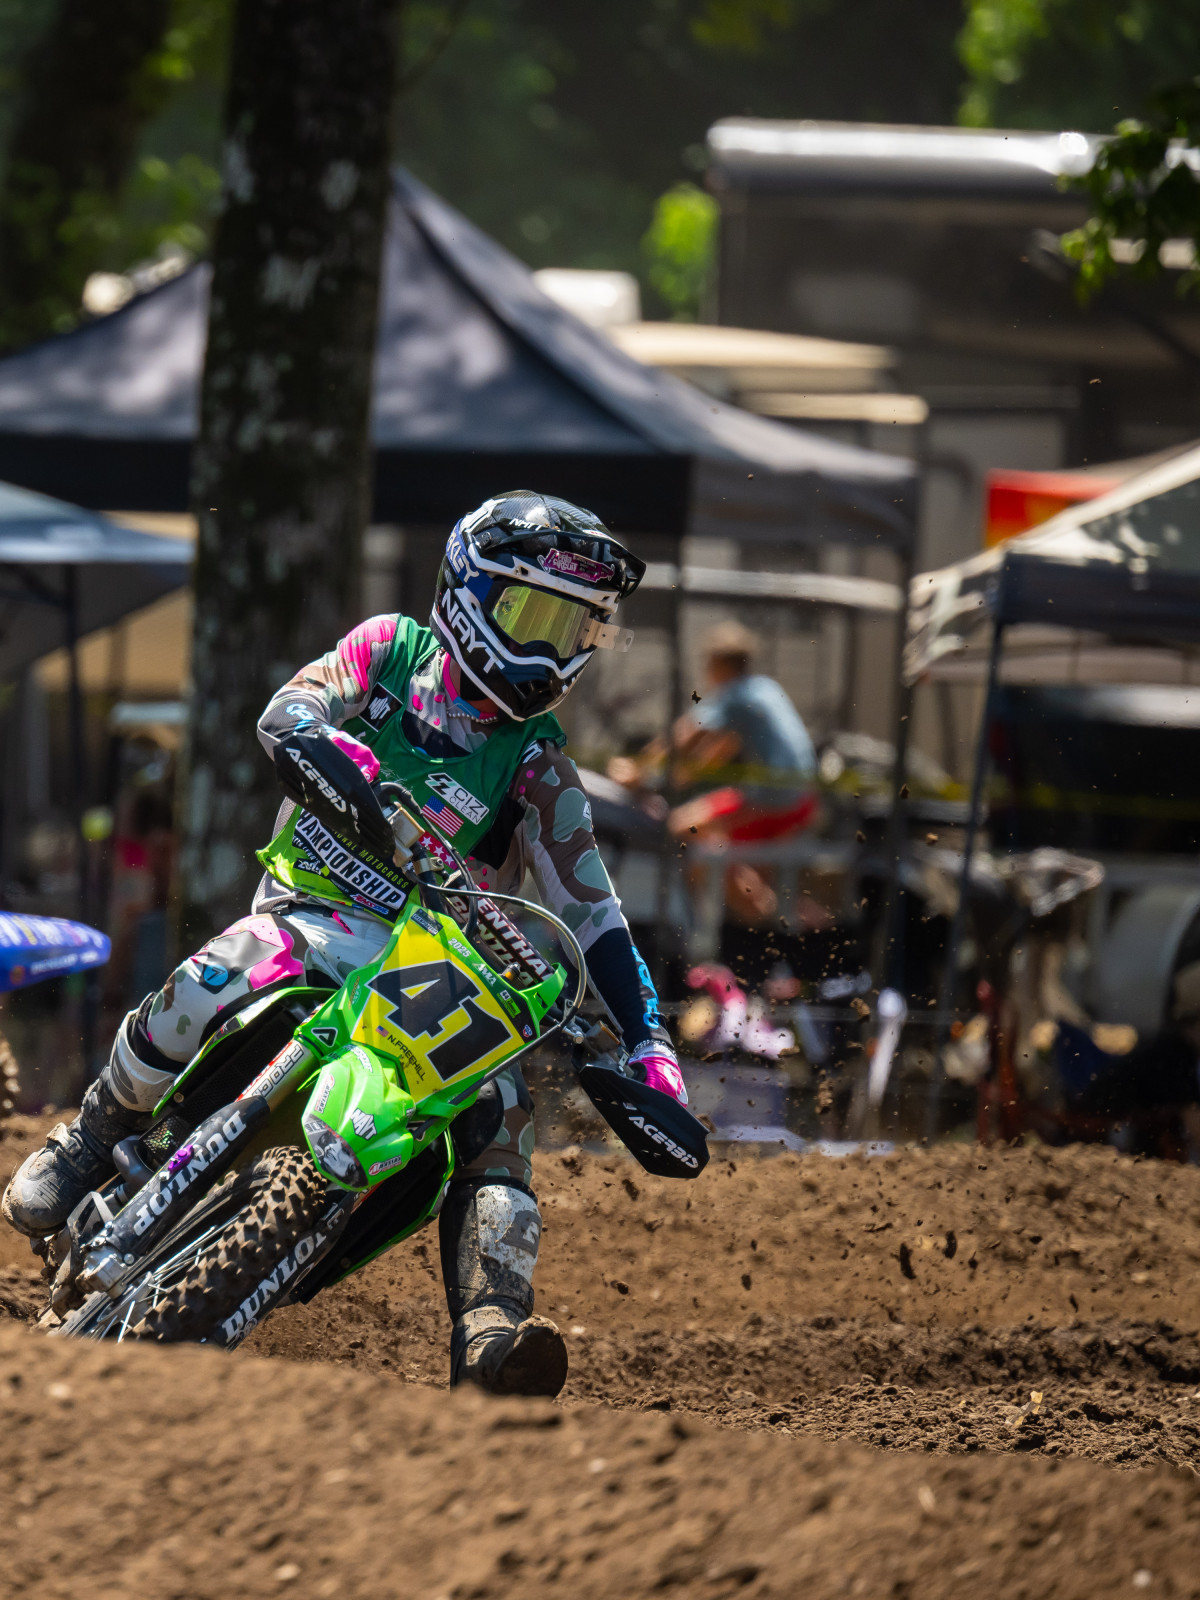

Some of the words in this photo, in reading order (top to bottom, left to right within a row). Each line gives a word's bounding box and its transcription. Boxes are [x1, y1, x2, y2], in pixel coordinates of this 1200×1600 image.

[441, 588, 506, 674] NAYT
[454, 787, 490, 819] CIZI
[296, 810, 402, 905] HAMPIONSHIP
[358, 849, 410, 889] MOTOCROSS
[448, 937, 472, 958] 2025
[476, 898, 553, 982] ENTHA
[472, 962, 497, 987] AMA
[364, 959, 513, 1083] 41
[387, 1034, 426, 1082] N.FREEHILL
[627, 1115, 699, 1169] ACERBIS
[133, 1110, 247, 1236] DUNLOP
